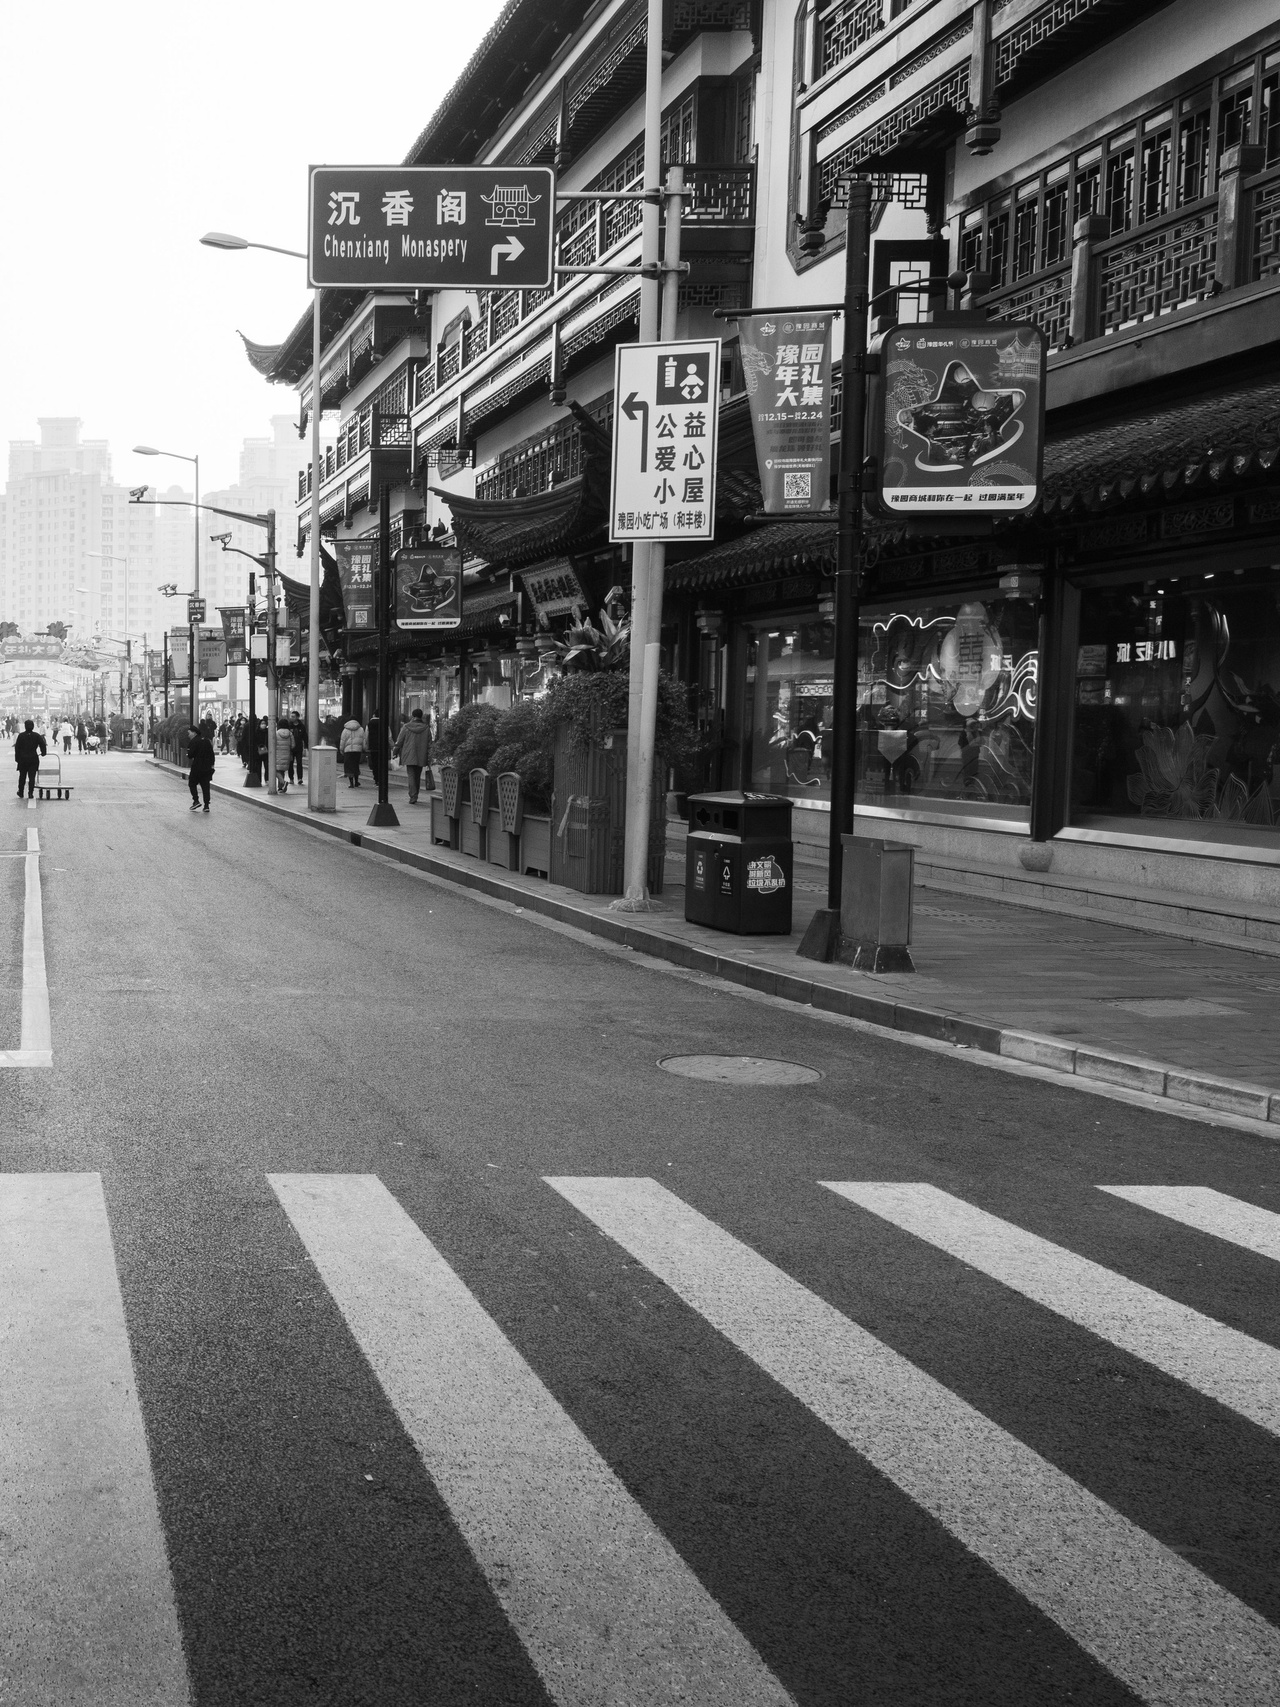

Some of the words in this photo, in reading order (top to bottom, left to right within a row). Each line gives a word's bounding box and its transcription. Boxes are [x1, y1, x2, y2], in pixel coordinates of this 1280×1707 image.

[327, 188, 467, 226] 沉香阁
[324, 233, 390, 264] Chenxiang
[401, 234, 468, 263] Monaspery
[775, 343, 825, 365] 豫园
[775, 364, 824, 386] 年礼
[775, 385, 824, 407] 大集
[655, 411, 706, 439] 公益
[654, 444, 706, 472] 爱心
[653, 477, 704, 505] 小屋
